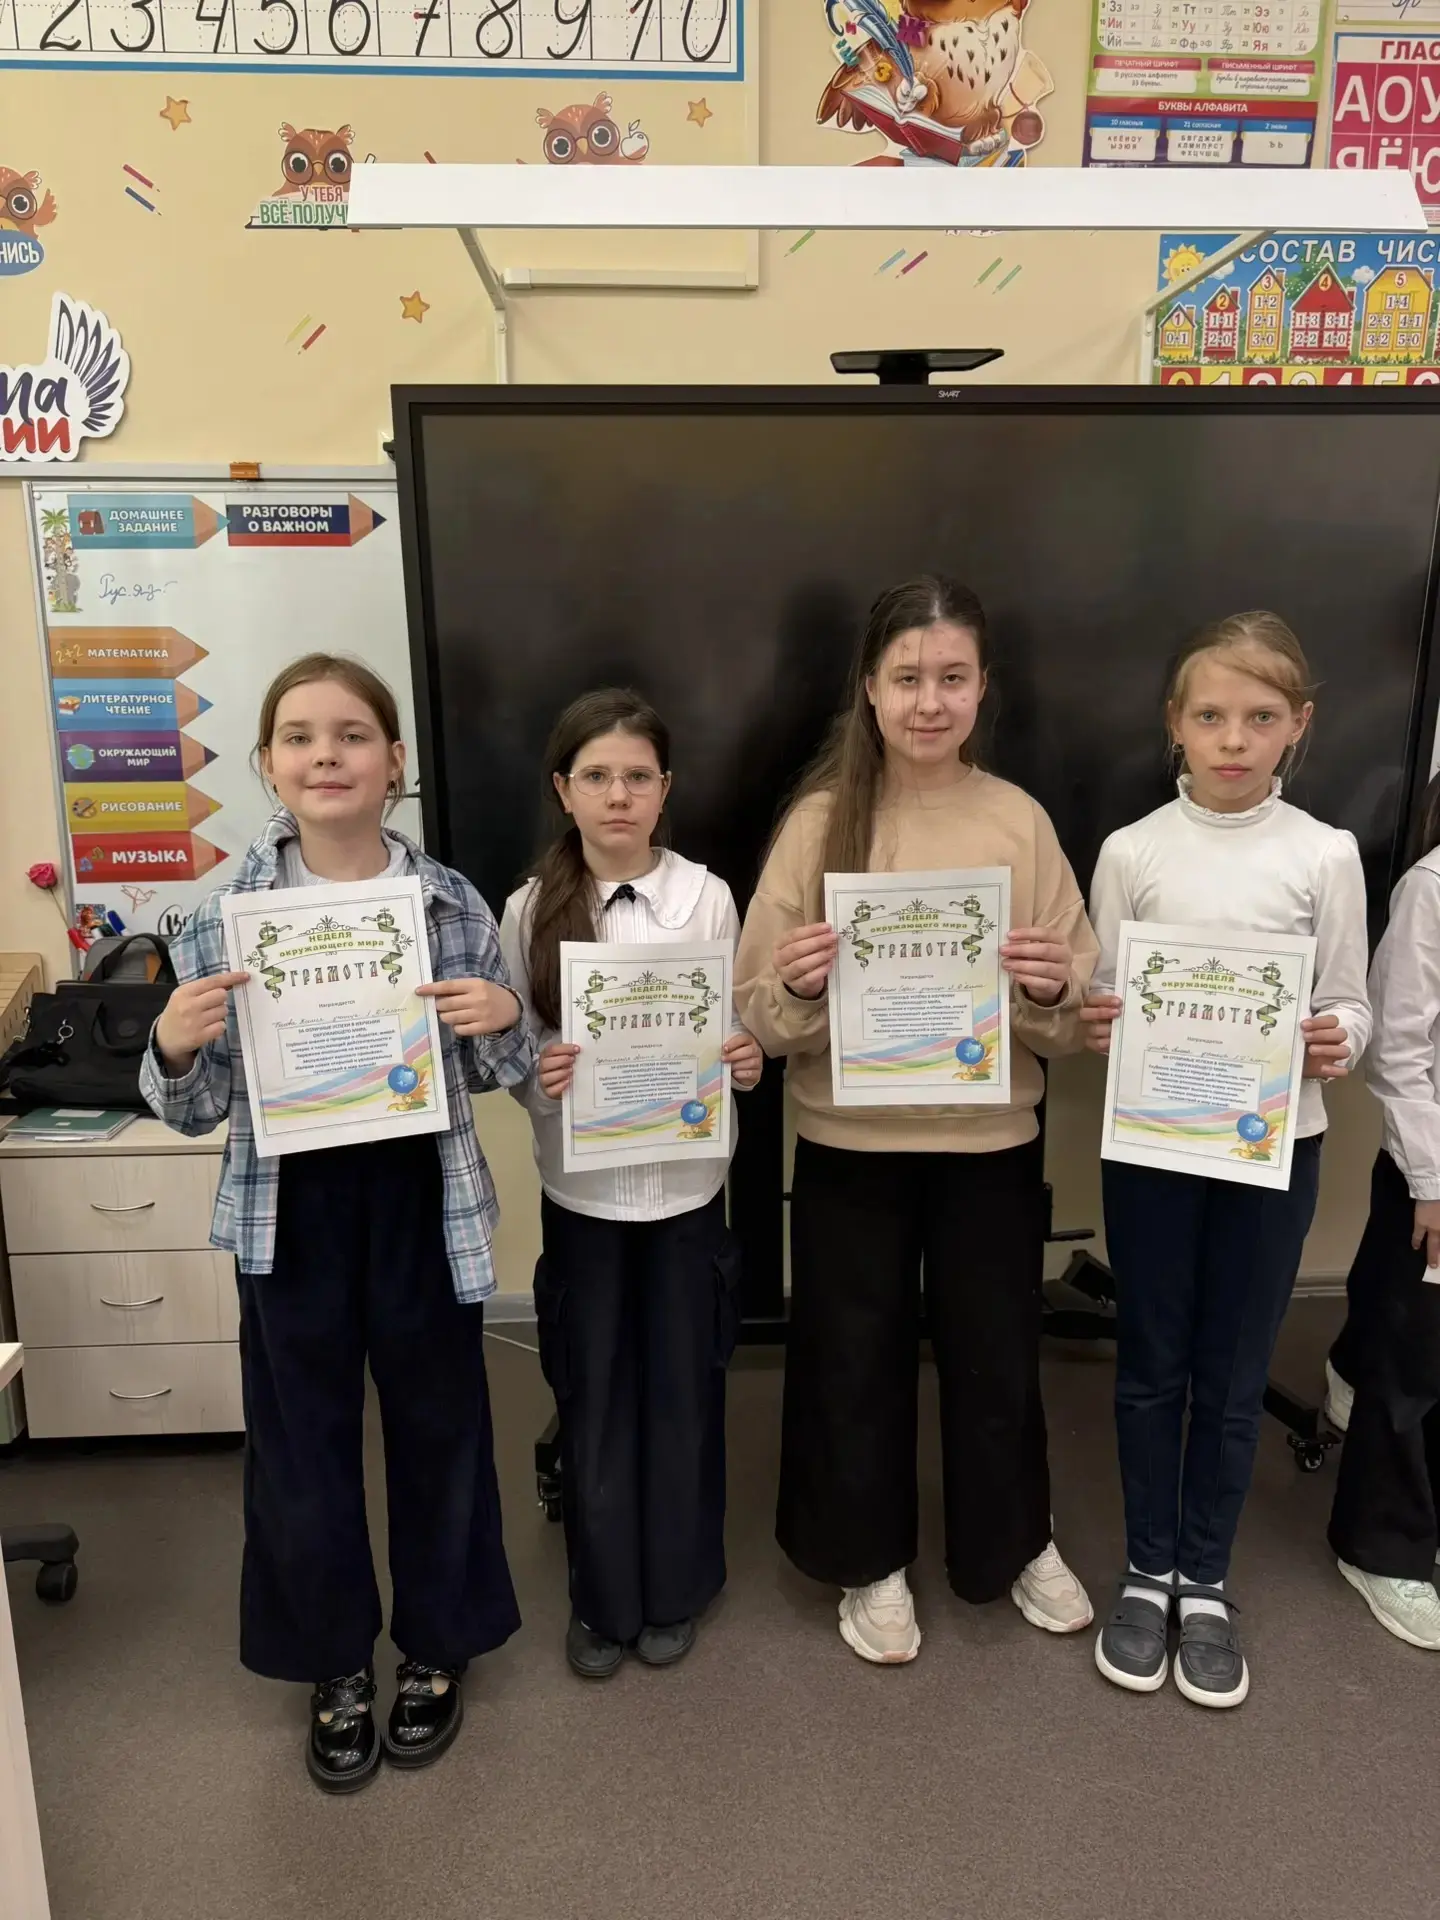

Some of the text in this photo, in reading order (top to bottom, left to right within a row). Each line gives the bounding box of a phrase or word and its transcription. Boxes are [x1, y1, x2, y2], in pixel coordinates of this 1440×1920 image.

[1183, 3, 1197, 15] Тт
[1254, 5, 1270, 17] Ээ
[1107, 17, 1122, 29] Ии
[1182, 19, 1196, 34] Уу
[1253, 22, 1270, 34] Юю
[1179, 37, 1198, 51] Фф
[1253, 39, 1269, 51] Яя
[1221, 61, 1271, 70] ПИСЬМЕННЫЙ
[1157, 101, 1248, 113] БУКВЫ АЛФАВИТА
[301, 186, 343, 202] У ТЕБЯ
[259, 201, 289, 224] ВСЁ
[1264, 275, 1271, 289] 3
[1320, 274, 1329, 288] 4
[938, 390, 961, 398] SMART
[109, 510, 184, 521] ДОМАШНЕЕ
[242, 506, 332, 518] РАЗГОВОРЫ
[118, 522, 178, 533] ЗАДАНИЕ
[248, 521, 329, 532] О ВАЖНОМ
[87, 649, 169, 659] МАТЕМАТИКА
[82, 694, 173, 704] ЛИТЕРАТУРНОЕ
[106, 705, 151, 715] ЧТЕНИЕ
[99, 746, 177, 757] ОКРУЖАЮЩИЙ
[127, 758, 150, 767] МИР
[101, 801, 182, 812] РИСОВАНИЕ
[112, 850, 188, 864] МУЗЫКА
[899, 913, 939, 921] НЕДЕЛЯ
[870, 923, 939, 933] окружающего
[309, 931, 352, 943] НЕДЕЛЯ
[280, 941, 354, 957] окружающего
[878, 941, 958, 958] ГРАМОТА
[290, 960, 378, 987] ГРАМОТА
[1192, 973, 1235, 983] НЕДЕЛЯ
[630, 985, 667, 993] НЕДЕЛЯ
[1161, 981, 1265, 997] окружающего мира
[603, 994, 668, 1004] окружающего
[1166, 1000, 1253, 1025] ГРАМОТА
[610, 1011, 686, 1031] ГРАМОТА
